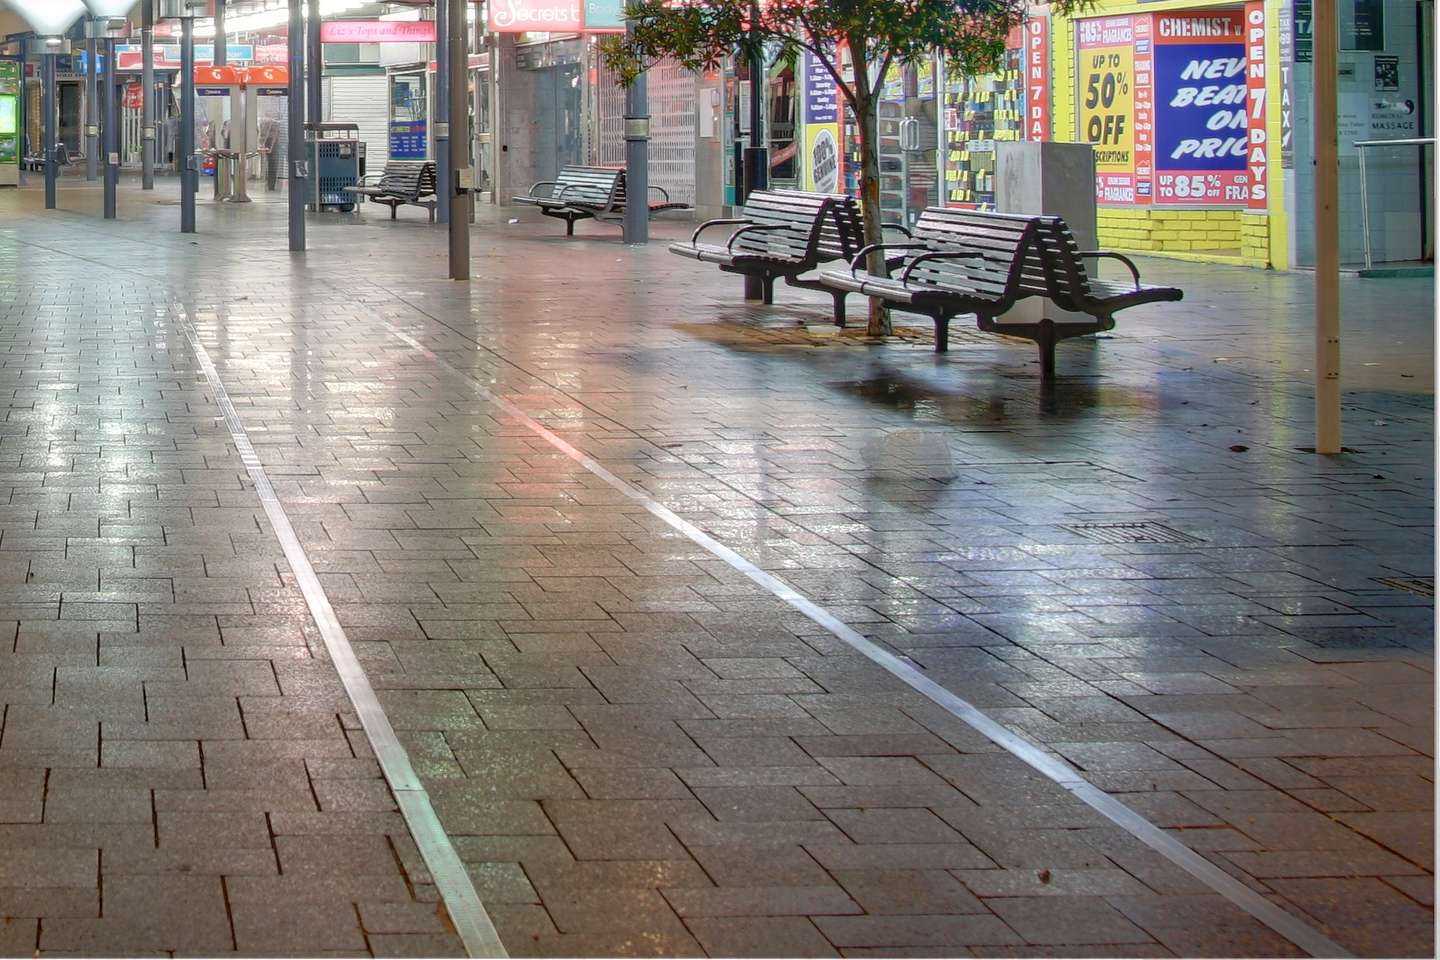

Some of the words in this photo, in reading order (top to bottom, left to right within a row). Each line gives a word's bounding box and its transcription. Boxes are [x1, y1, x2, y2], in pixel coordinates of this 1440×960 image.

[1160, 16, 1232, 37] CHEMIST
[1031, 21, 1042, 79] OPEN
[1249, 9, 1264, 79] OPEN
[1093, 54, 1105, 69] UP
[1108, 54, 1121, 68] TO
[1180, 57, 1248, 81] NEV
[1031, 86, 1043, 100] 7
[1250, 88, 1266, 119] 7
[1281, 67, 1291, 128] TAX
[1087, 115, 1126, 146] OFF
[1095, 150, 1129, 162] SCRIPTIONS
[1170, 136, 1248, 160] PRIC
[1249, 128, 1266, 200] DAYS
[1160, 176, 1173, 185] UP
[1234, 176, 1248, 184] GEN
[1160, 187, 1173, 197] TO
[1207, 188, 1220, 197] OFF
[1225, 186, 1248, 200] FRA
